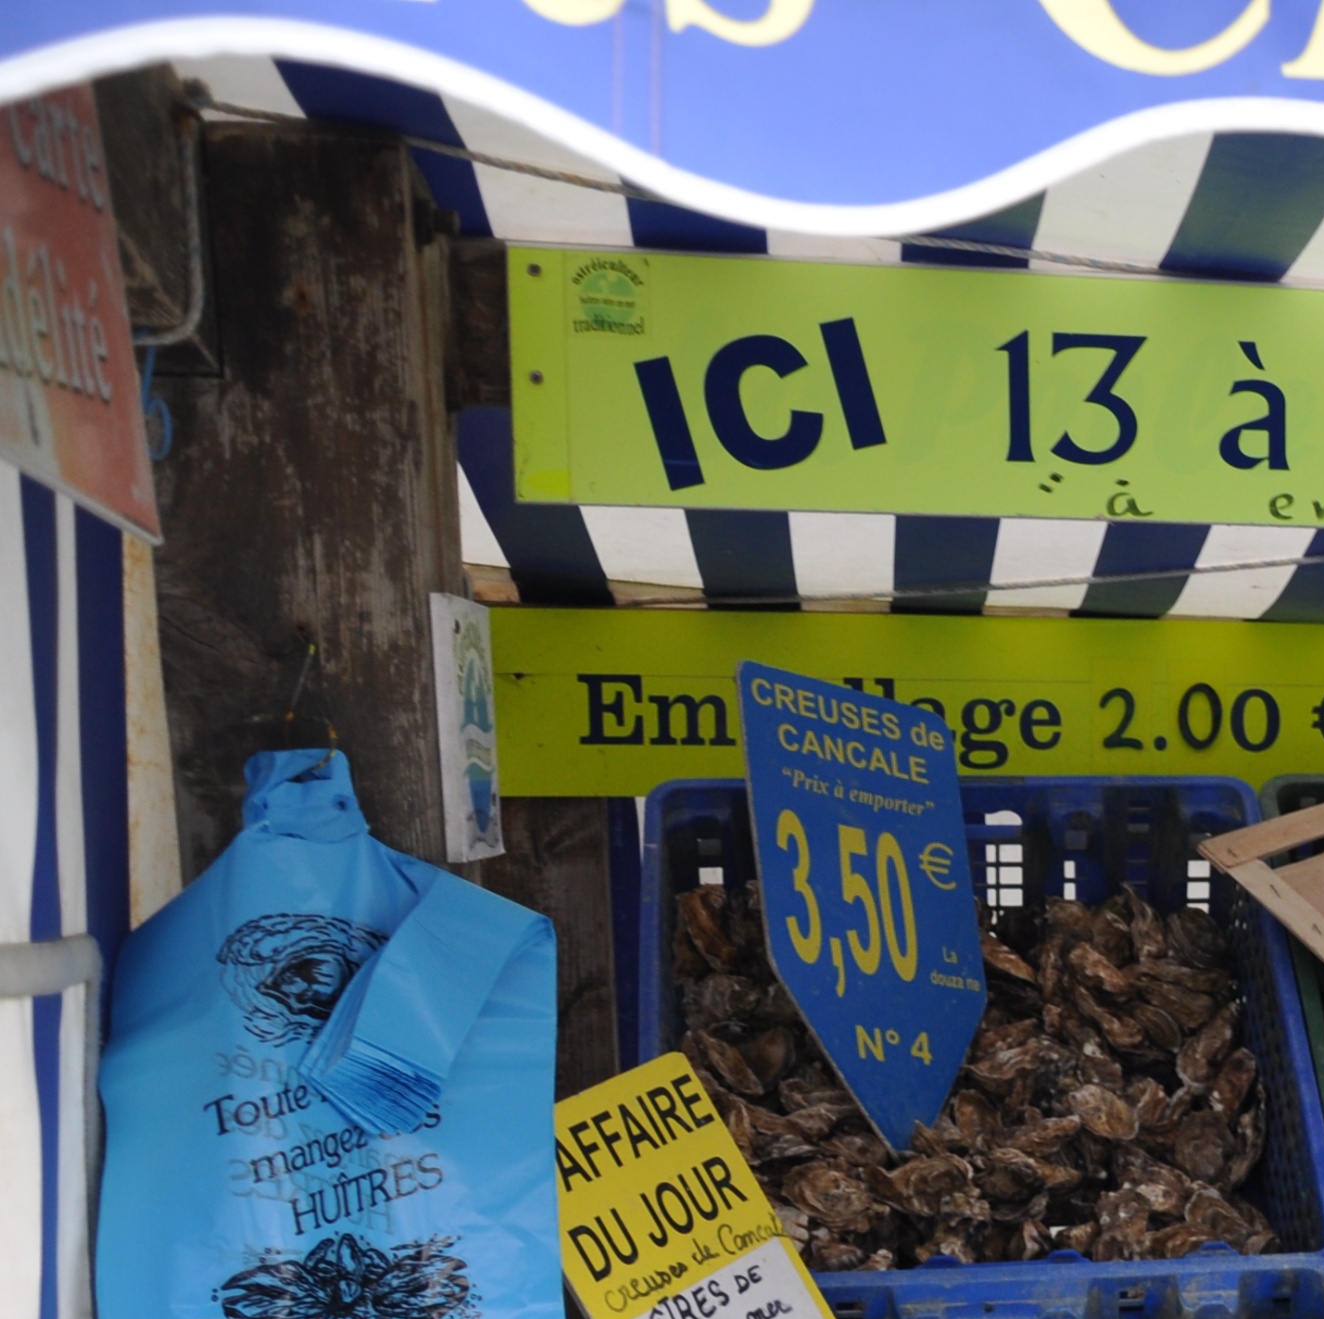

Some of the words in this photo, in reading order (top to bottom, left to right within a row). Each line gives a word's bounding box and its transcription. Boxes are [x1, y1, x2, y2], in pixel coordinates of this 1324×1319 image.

[0, 225, 113, 404] délité
[634, 316, 888, 491] ICI
[994, 329, 1148, 466] 13
[1218, 340, 1290, 470] à
[751, 677, 901, 741] CREUSES
[910, 721, 946, 751] de
[1098, 682, 1281, 753] 2.00
[777, 723, 930, 785] CANCALE
[834, 778, 845, 799] à
[776, 809, 918, 998] 3,50
[919, 842, 956, 890] €
[942, 946, 957, 965] La
[910, 1032, 933, 1066] 4
[203, 1082, 312, 1136] Toute
[554, 1073, 714, 1193] AFFAIRE
[249, 1125, 370, 1183] mangez
[290, 1152, 444, 1236] HUÎTRES
[567, 1207, 638, 1283] DU
[647, 1155, 748, 1248] JOUR
[734, 1265, 763, 1294] DE
